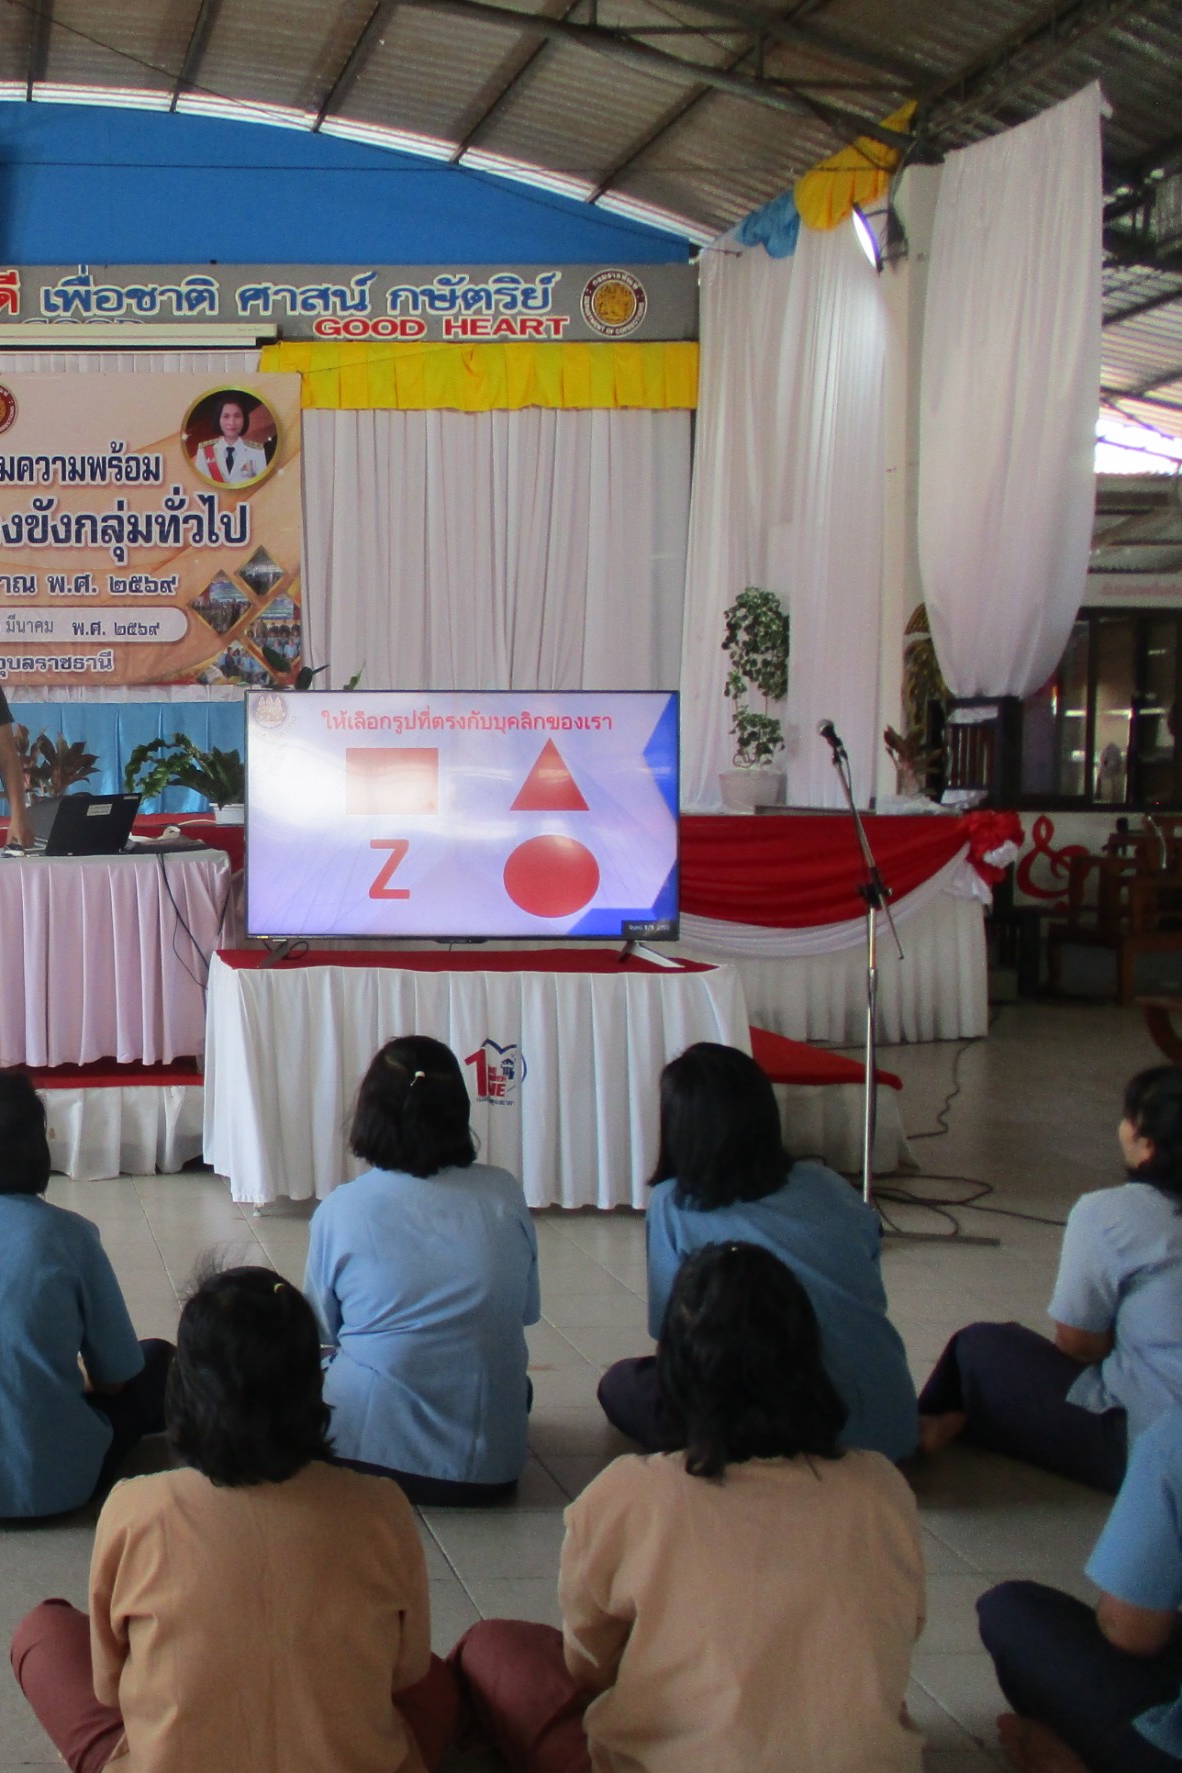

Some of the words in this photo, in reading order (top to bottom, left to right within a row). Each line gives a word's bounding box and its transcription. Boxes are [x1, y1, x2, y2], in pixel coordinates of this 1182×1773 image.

[39, 264, 220, 318] เพื่อชาติ
[235, 269, 380, 317] ศาสน์
[385, 270, 562, 316] กษัตริย์
[312, 316, 427, 340] GOOD
[442, 315, 570, 339] HEART
[48, 574, 97, 594] พ.ศ.
[109, 574, 177, 594] ๒๕๖๙
[5, 613, 54, 634] มีนาคม
[72, 620, 106, 636] พ.ศ.
[113, 621, 160, 636] ๒๕๖๙
[321, 706, 613, 734] ให้เลือกรูปที่ตรงกับบุคลิกของเรา
[369, 838, 411, 900] Z
